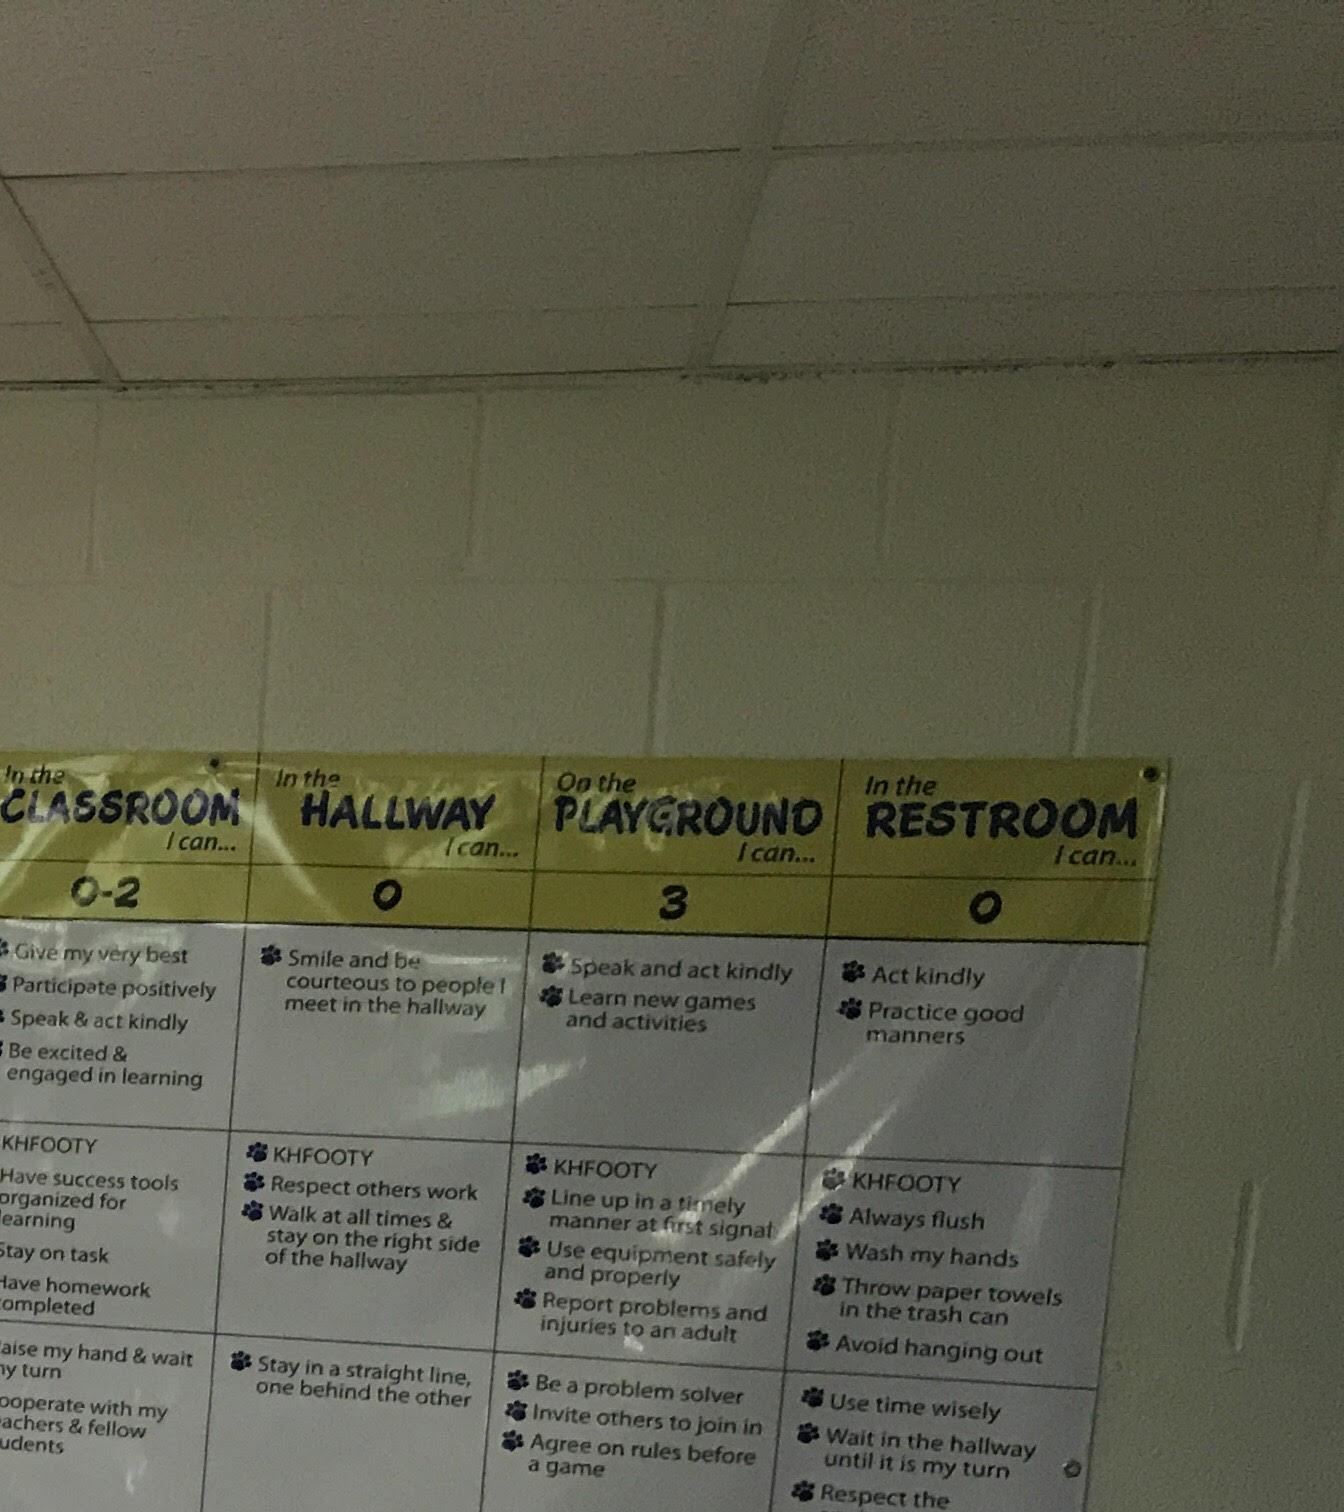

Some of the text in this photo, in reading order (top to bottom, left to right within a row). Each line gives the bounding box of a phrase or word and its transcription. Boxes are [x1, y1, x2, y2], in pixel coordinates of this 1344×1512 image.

[4, 764, 66, 785] In the
[275, 768, 341, 788] In the
[556, 771, 637, 794] On the
[864, 774, 937, 797] In the
[0, 787, 240, 827] CLASSROOM
[301, 792, 496, 831] HALLWAY
[554, 794, 825, 837] PLAYGROUND
[867, 798, 1138, 840] RESTROOM
[166, 830, 175, 850] I
[444, 837, 455, 857] I
[736, 842, 748, 862] I
[1053, 845, 1065, 865] I
[70, 875, 141, 909] 0-2
[658, 884, 689, 921] 3
[12, 975, 217, 1003] Participate positively
[871, 965, 986, 990] Act kindly
[284, 995, 487, 1020] meet in the hallway
[568, 987, 756, 1013] Learn new games
[273, 1146, 374, 1167] KHFOOTY
[0, 1167, 179, 1192] Have success tools
[271, 1174, 478, 1201] Respect others work
[99, 1192, 127, 1210] for
[848, 1207, 985, 1232] Always flush
[546, 1240, 777, 1273] Use equipment safely
[544, 1263, 681, 1290] and properly
[835, 1334, 1043, 1365] Avoid hanging out
[830, 1393, 1002, 1424] Use time wisely
